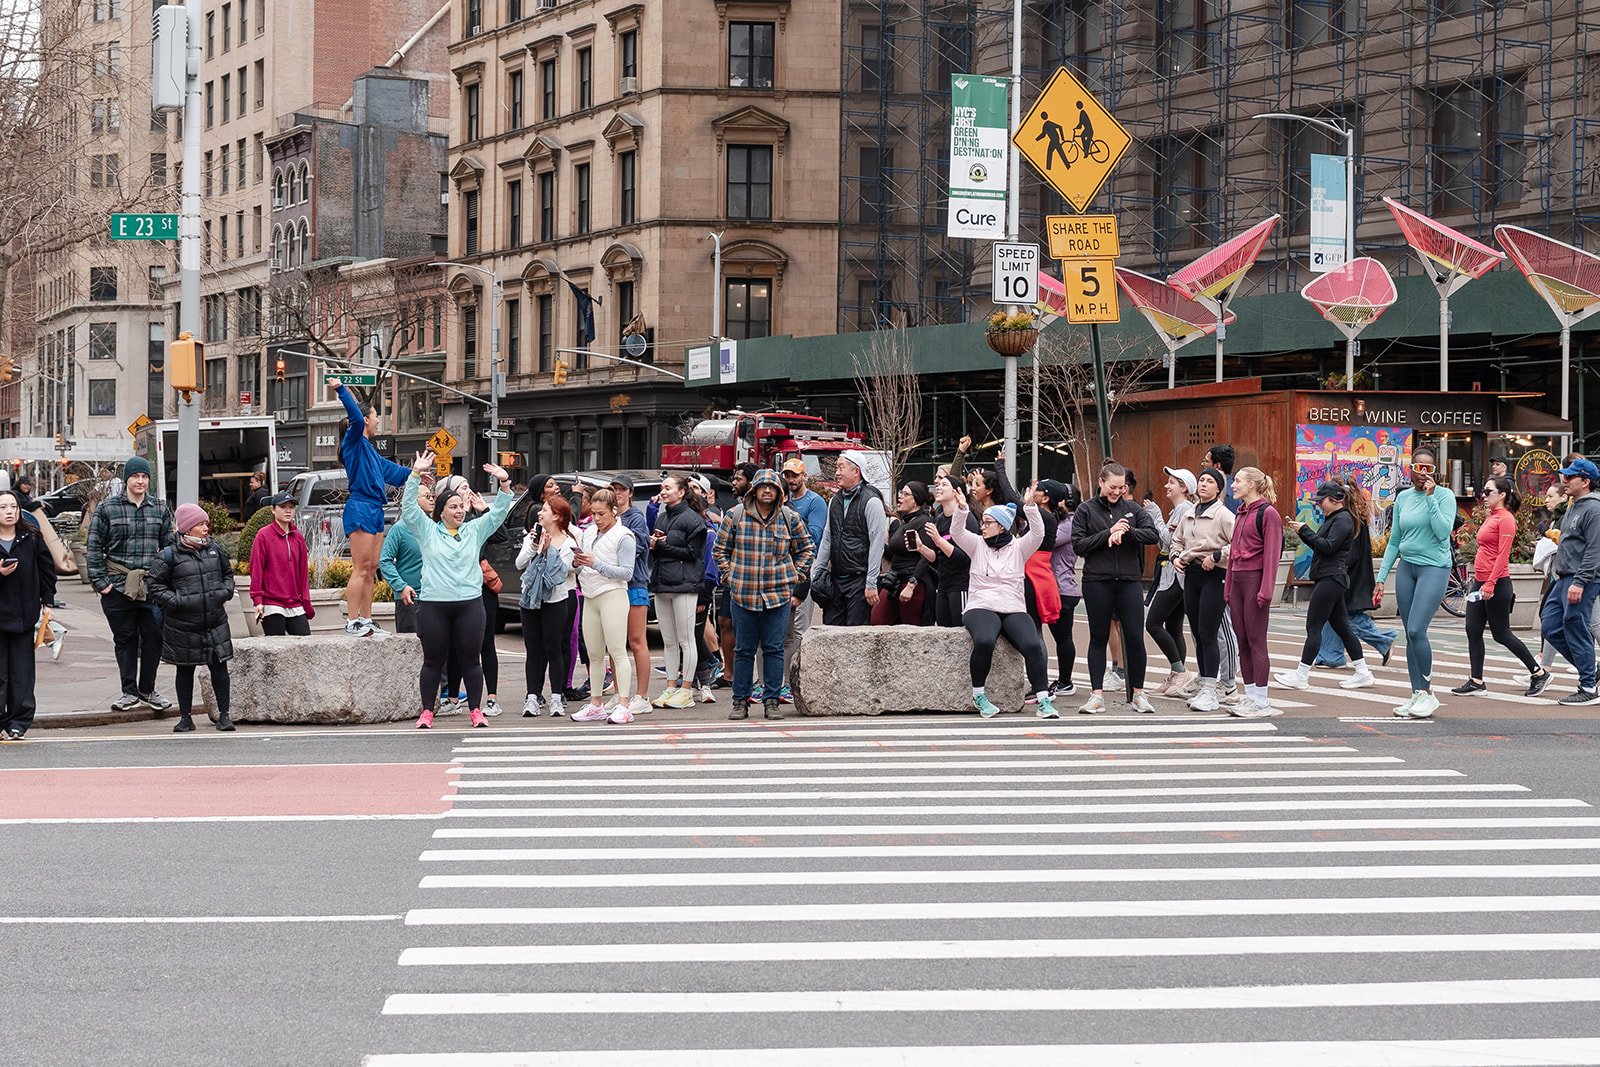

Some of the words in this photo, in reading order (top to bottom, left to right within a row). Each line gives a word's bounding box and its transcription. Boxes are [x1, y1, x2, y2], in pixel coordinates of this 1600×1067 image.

[954, 106, 977, 118] NYC'S
[953, 117, 976, 127] FIRST
[953, 127, 978, 137] GREEN
[119, 217, 128, 236] E
[135, 217, 154, 237] 23
[161, 217, 173, 230] St
[1053, 222, 1089, 235] SHARE
[1093, 222, 1113, 234] THE
[1069, 239, 1100, 251] ROAD
[998, 248, 1035, 260] SPEED
[1325, 253, 1342, 262] GFP
[1001, 261, 1031, 272] LIMIT
[1003, 276, 1029, 298] 10
[1081, 267, 1100, 297] 5
[1075, 302, 1111, 315] M.P.H.
[343, 376, 353, 384] 22
[355, 376, 363, 384] St
[1309, 407, 1351, 422] BEER
[1365, 409, 1407, 424] WINE
[1419, 410, 1483, 425] COFFEE
[1519, 454, 1532, 471] HOT
[1532, 452, 1558, 472] MULLED
